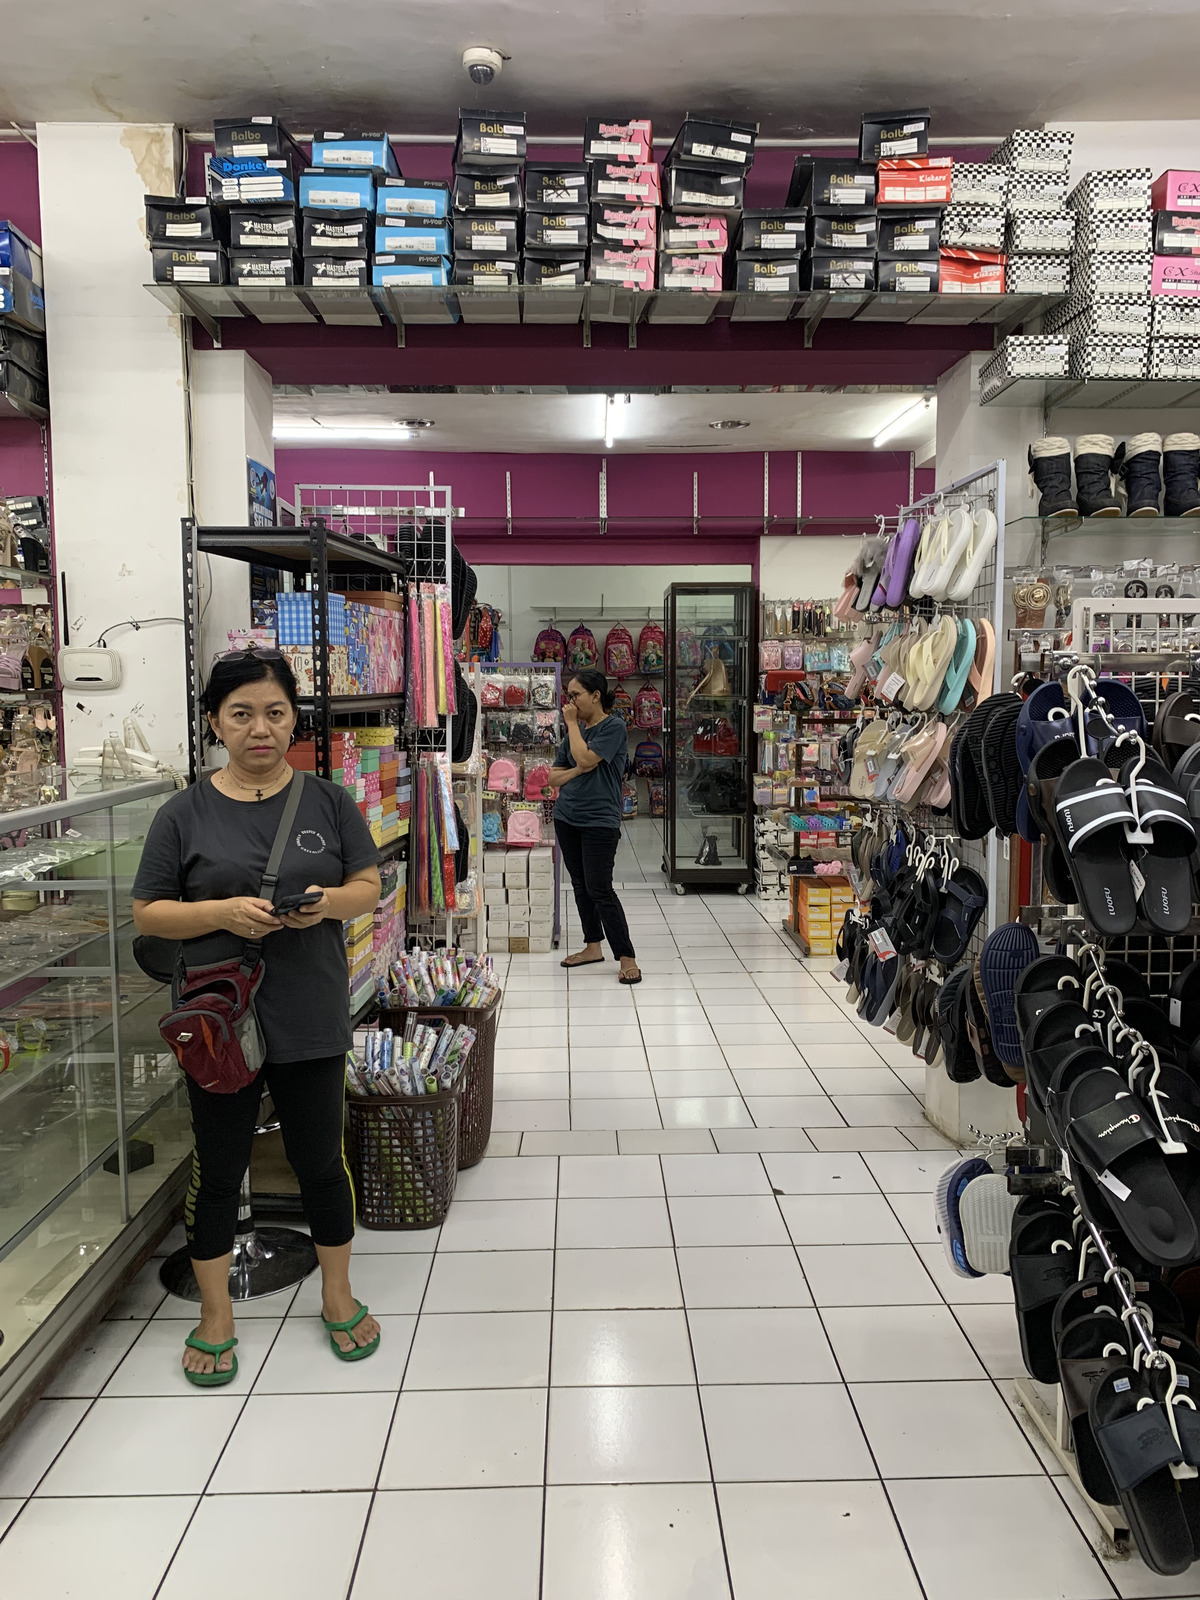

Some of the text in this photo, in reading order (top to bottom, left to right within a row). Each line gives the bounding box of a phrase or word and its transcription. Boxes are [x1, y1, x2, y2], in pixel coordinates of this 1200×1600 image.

[480, 123, 507, 134] Balb
[231, 131, 261, 141] Balbo
[830, 174, 855, 184] Balb
[919, 174, 946, 183] Kickers
[166, 212, 196, 221] Balbo
[542, 216, 566, 226] Balb
[253, 222, 273, 230] MASTER
[760, 220, 785, 230] Balb
[172, 252, 202, 262] Balb
[251, 263, 270, 271] MASTER
[754, 264, 778, 274] Balb
[830, 260, 854, 270] Balb
[1063, 808, 1075, 833] LUOFU
[1104, 887, 1115, 915] LUOFU
[1161, 887, 1171, 915] LUOFU
[1097, 1114, 1141, 1138] Champion
